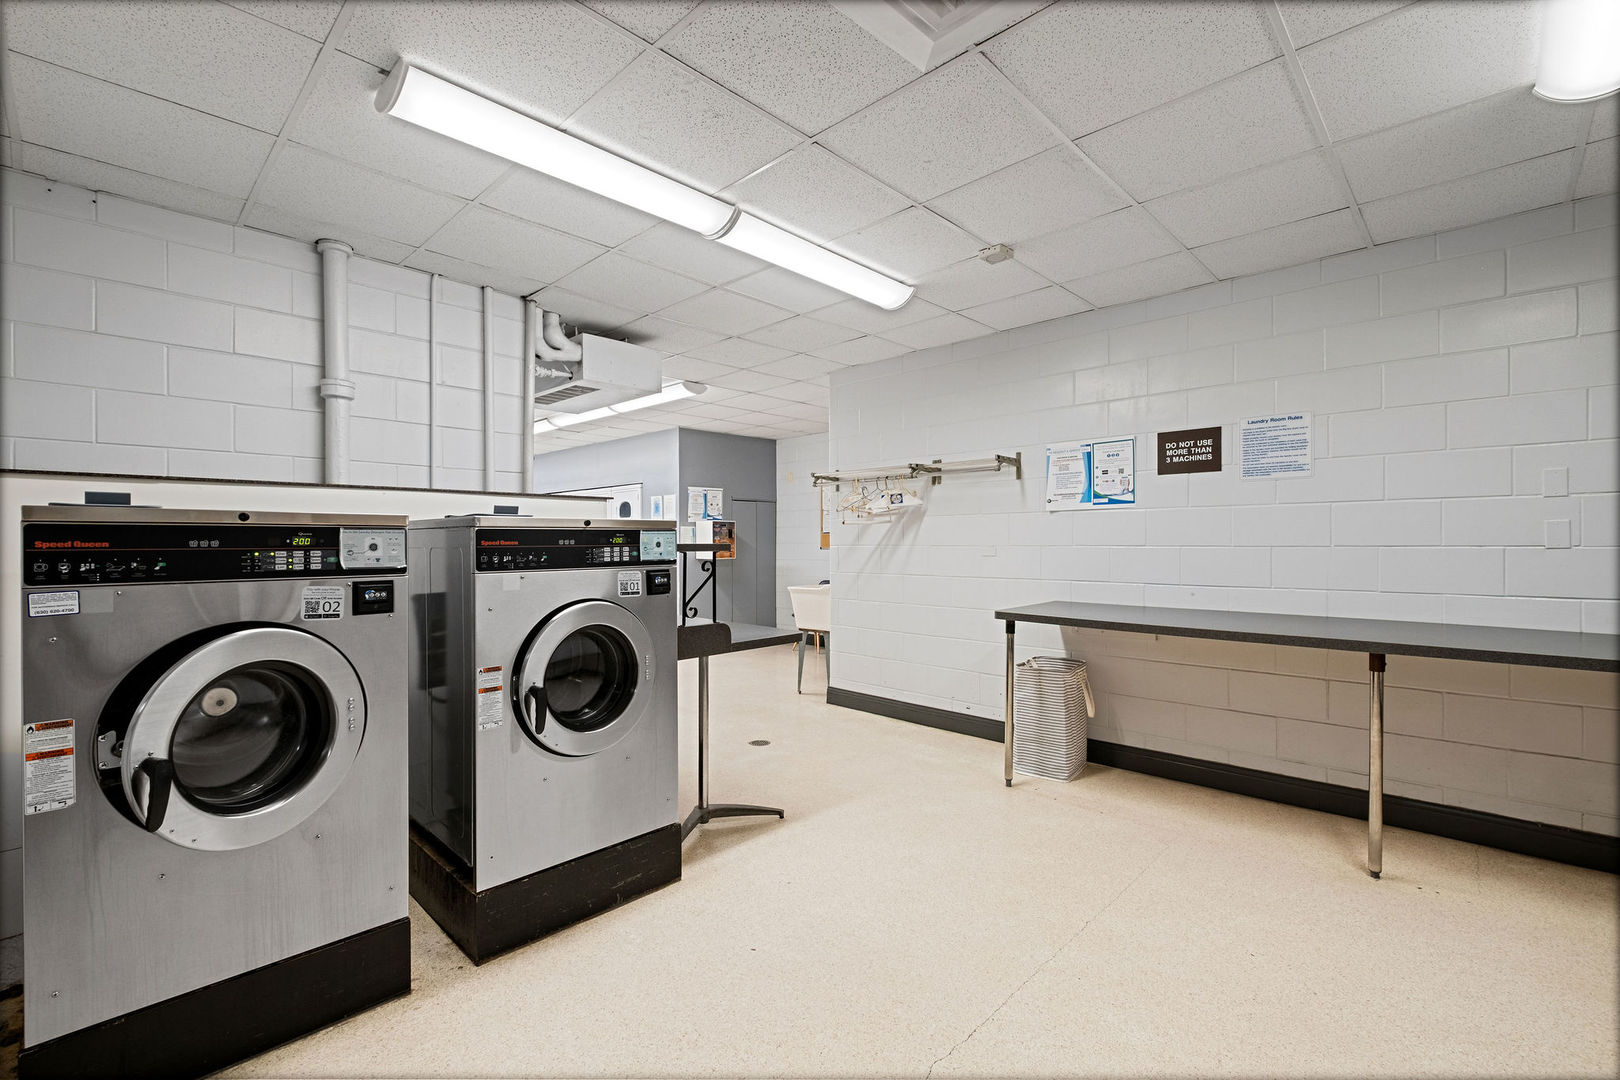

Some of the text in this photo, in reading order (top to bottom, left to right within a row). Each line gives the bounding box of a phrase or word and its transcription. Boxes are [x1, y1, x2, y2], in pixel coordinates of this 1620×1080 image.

[1179, 440, 1194, 448] NOT
[1197, 438, 1213, 446] USE
[1166, 448, 1188, 456] MORE
[1172, 454, 1212, 462] MACHINES
[34, 541, 72, 549] Speed
[292, 537, 311, 545] 200
[629, 581, 640, 591] 01
[322, 600, 341, 613] 02
